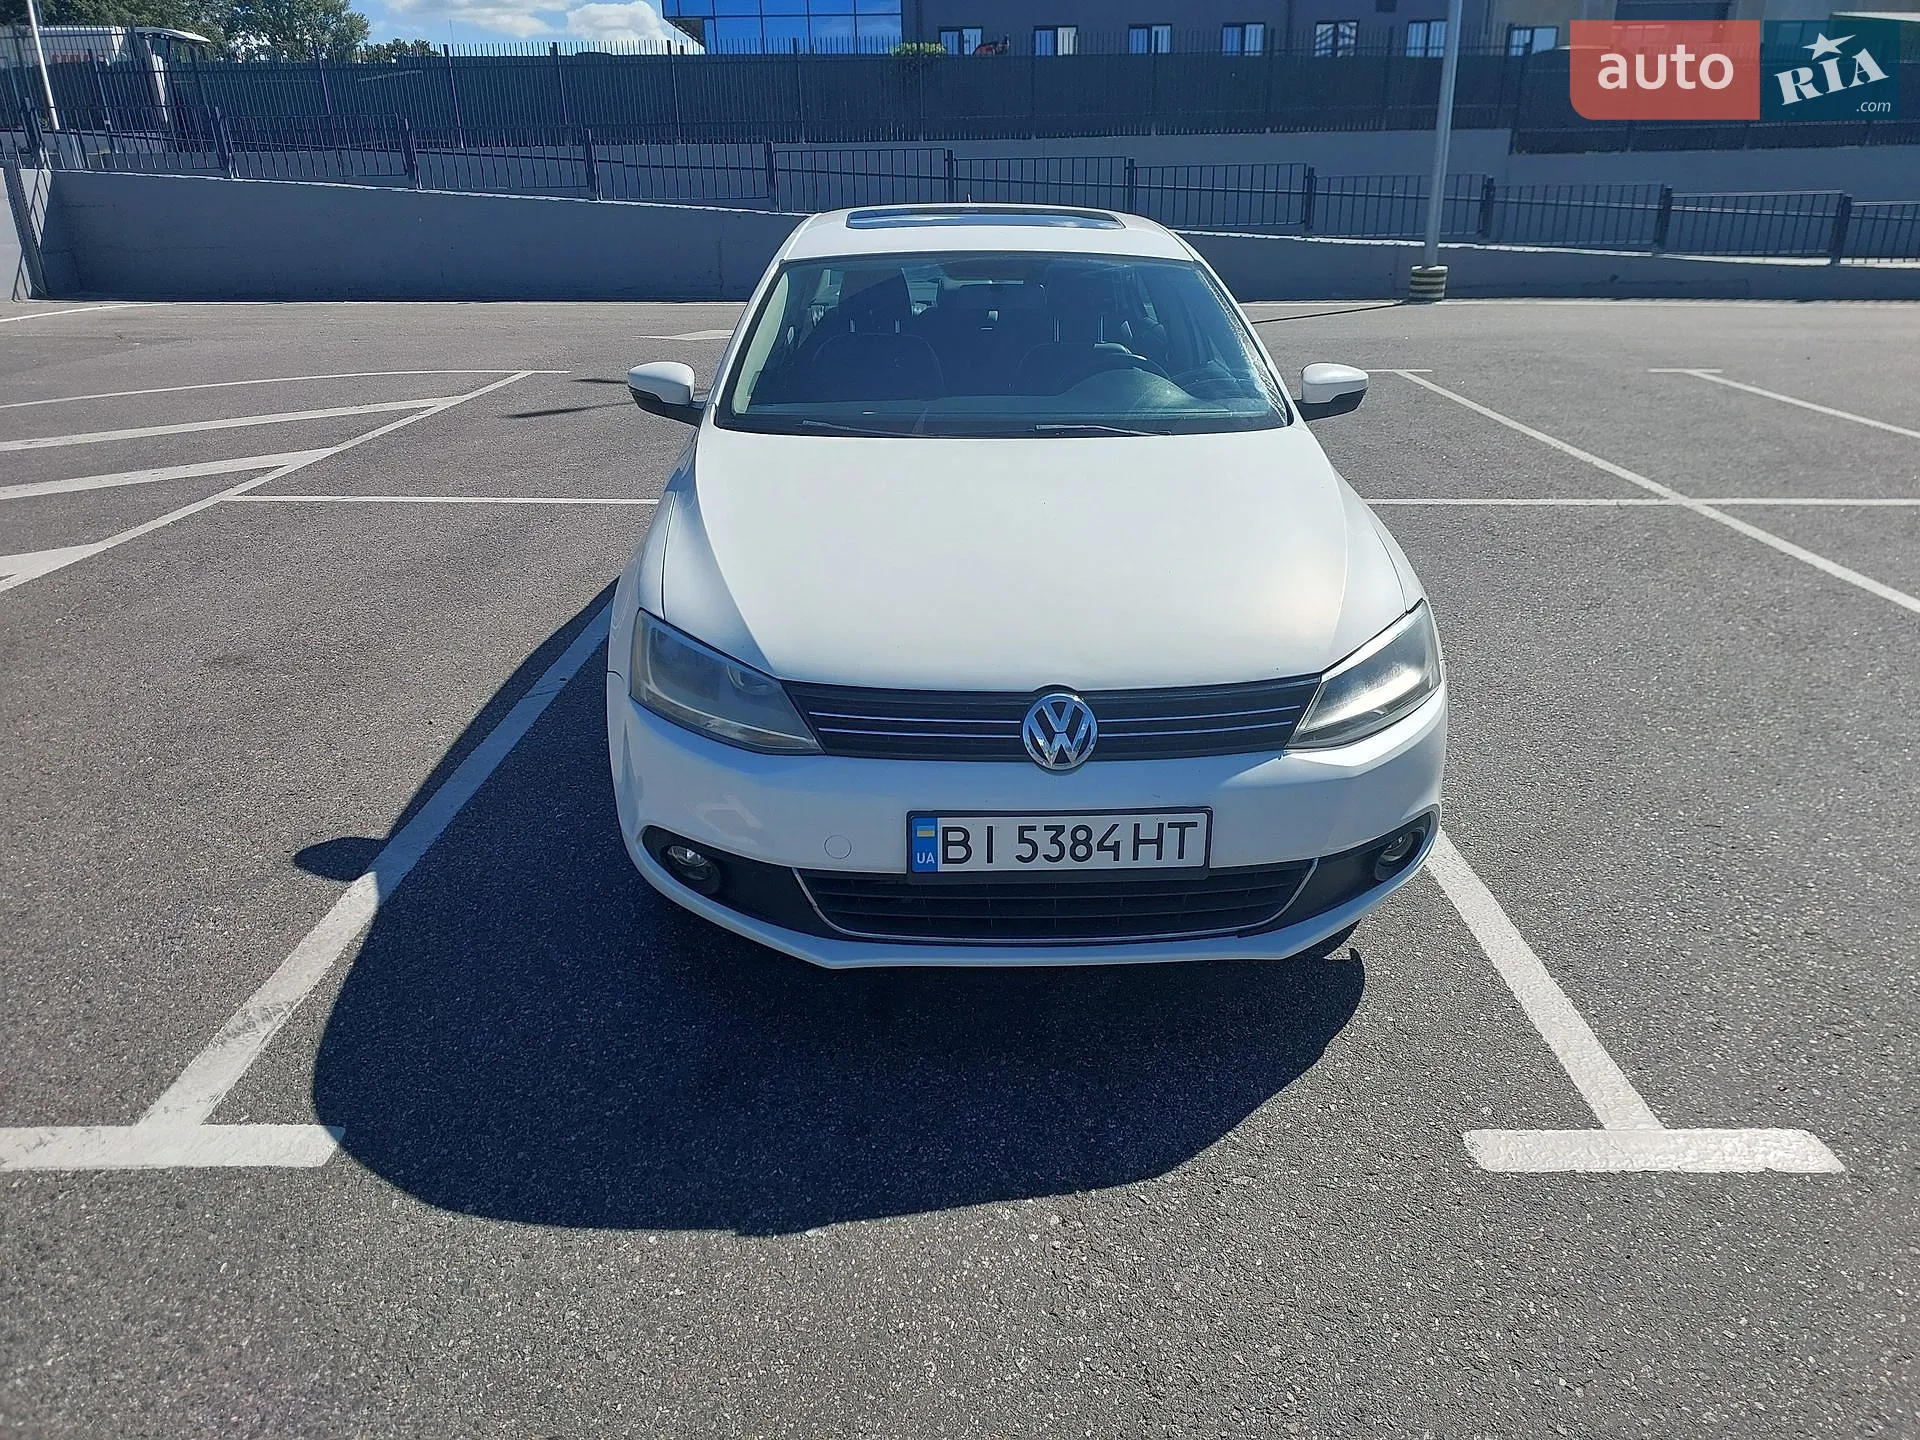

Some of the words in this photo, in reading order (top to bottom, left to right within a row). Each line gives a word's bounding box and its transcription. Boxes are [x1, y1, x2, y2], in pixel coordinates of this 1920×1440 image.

[1023, 693, 1097, 770] VW
[916, 853, 935, 864] UA
[941, 825, 993, 865] BI
[1014, 824, 1121, 863] 5384
[1132, 821, 1198, 861] HT
